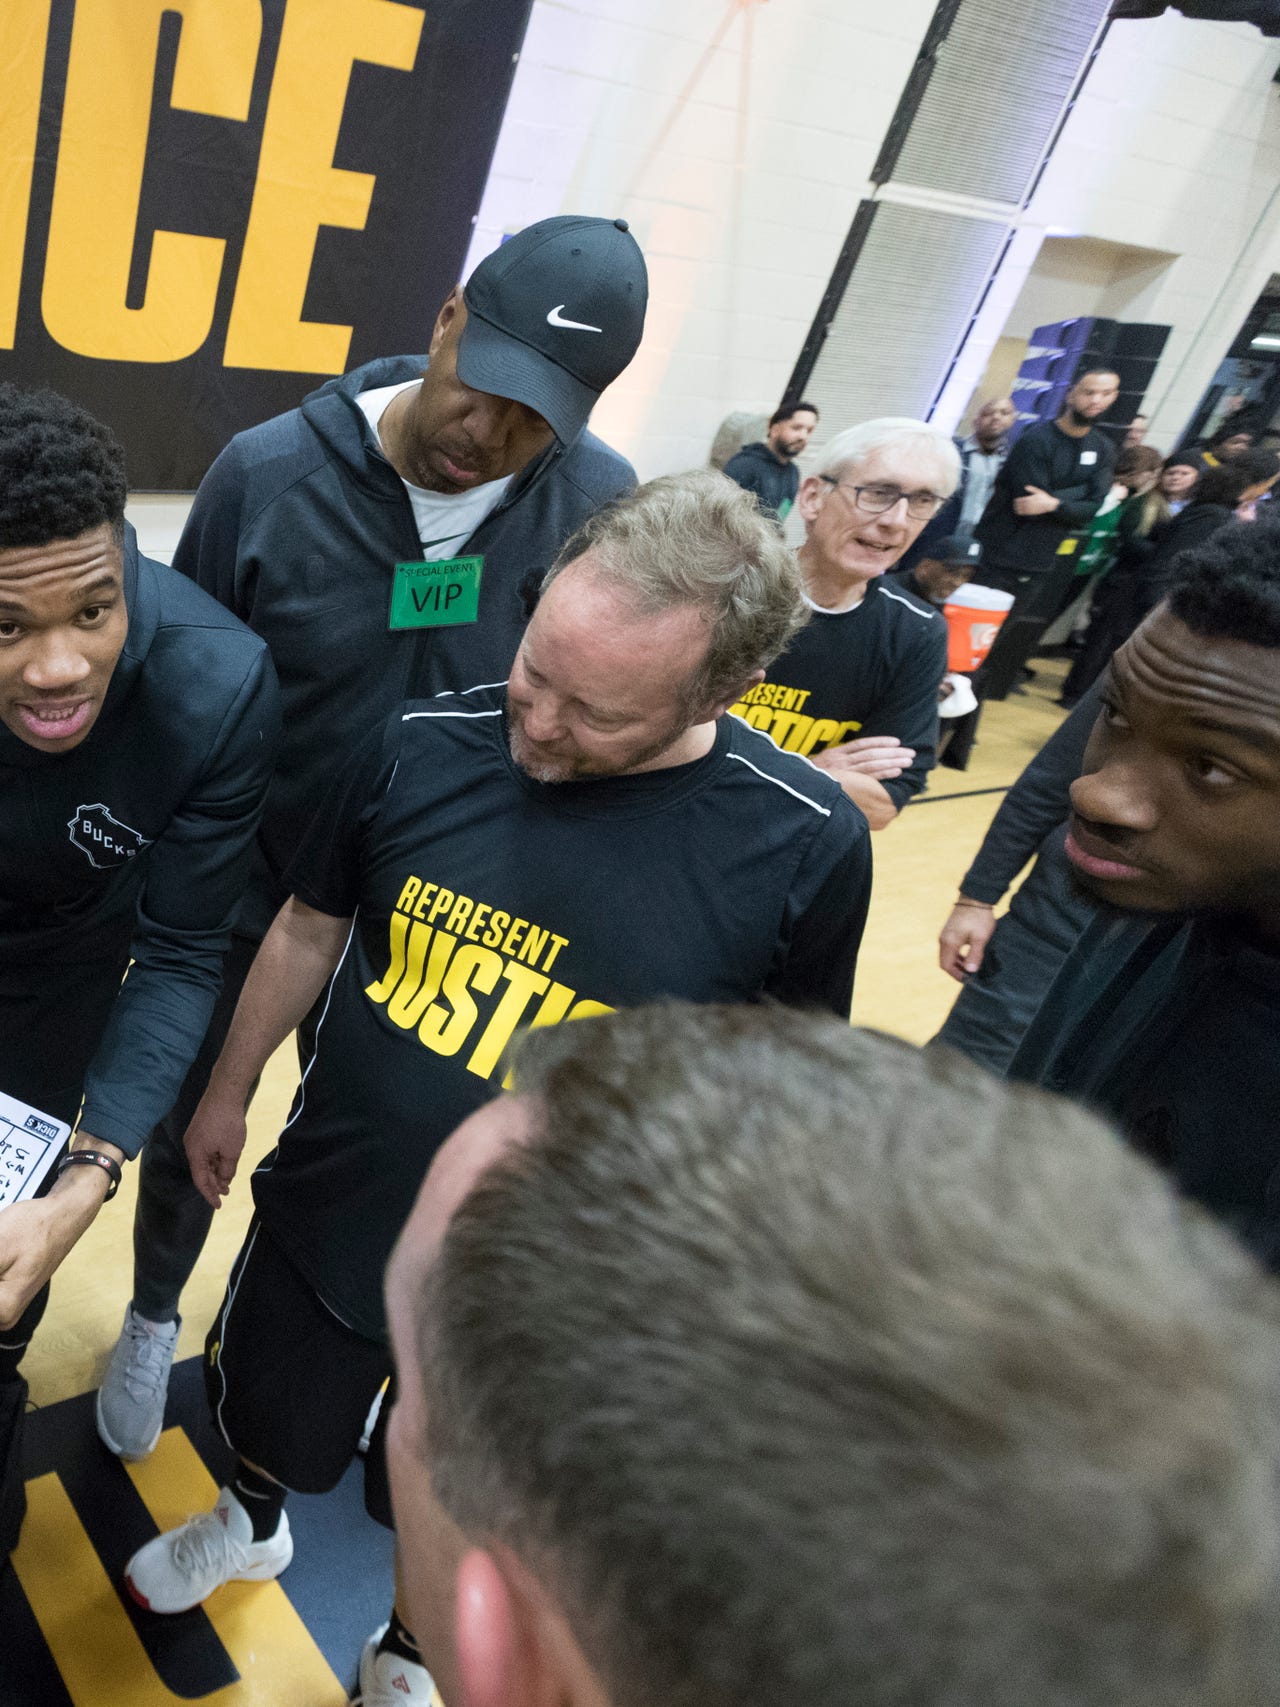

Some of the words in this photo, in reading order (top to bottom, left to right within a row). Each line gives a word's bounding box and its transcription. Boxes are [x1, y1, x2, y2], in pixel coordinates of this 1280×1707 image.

[405, 567, 441, 578] SPECIAL
[444, 563, 474, 574] EVENT
[411, 583, 463, 613] VIP
[83, 820, 137, 857] BUCKS
[396, 875, 570, 973] REPRESENT
[26, 1118, 57, 1138] DICKS
